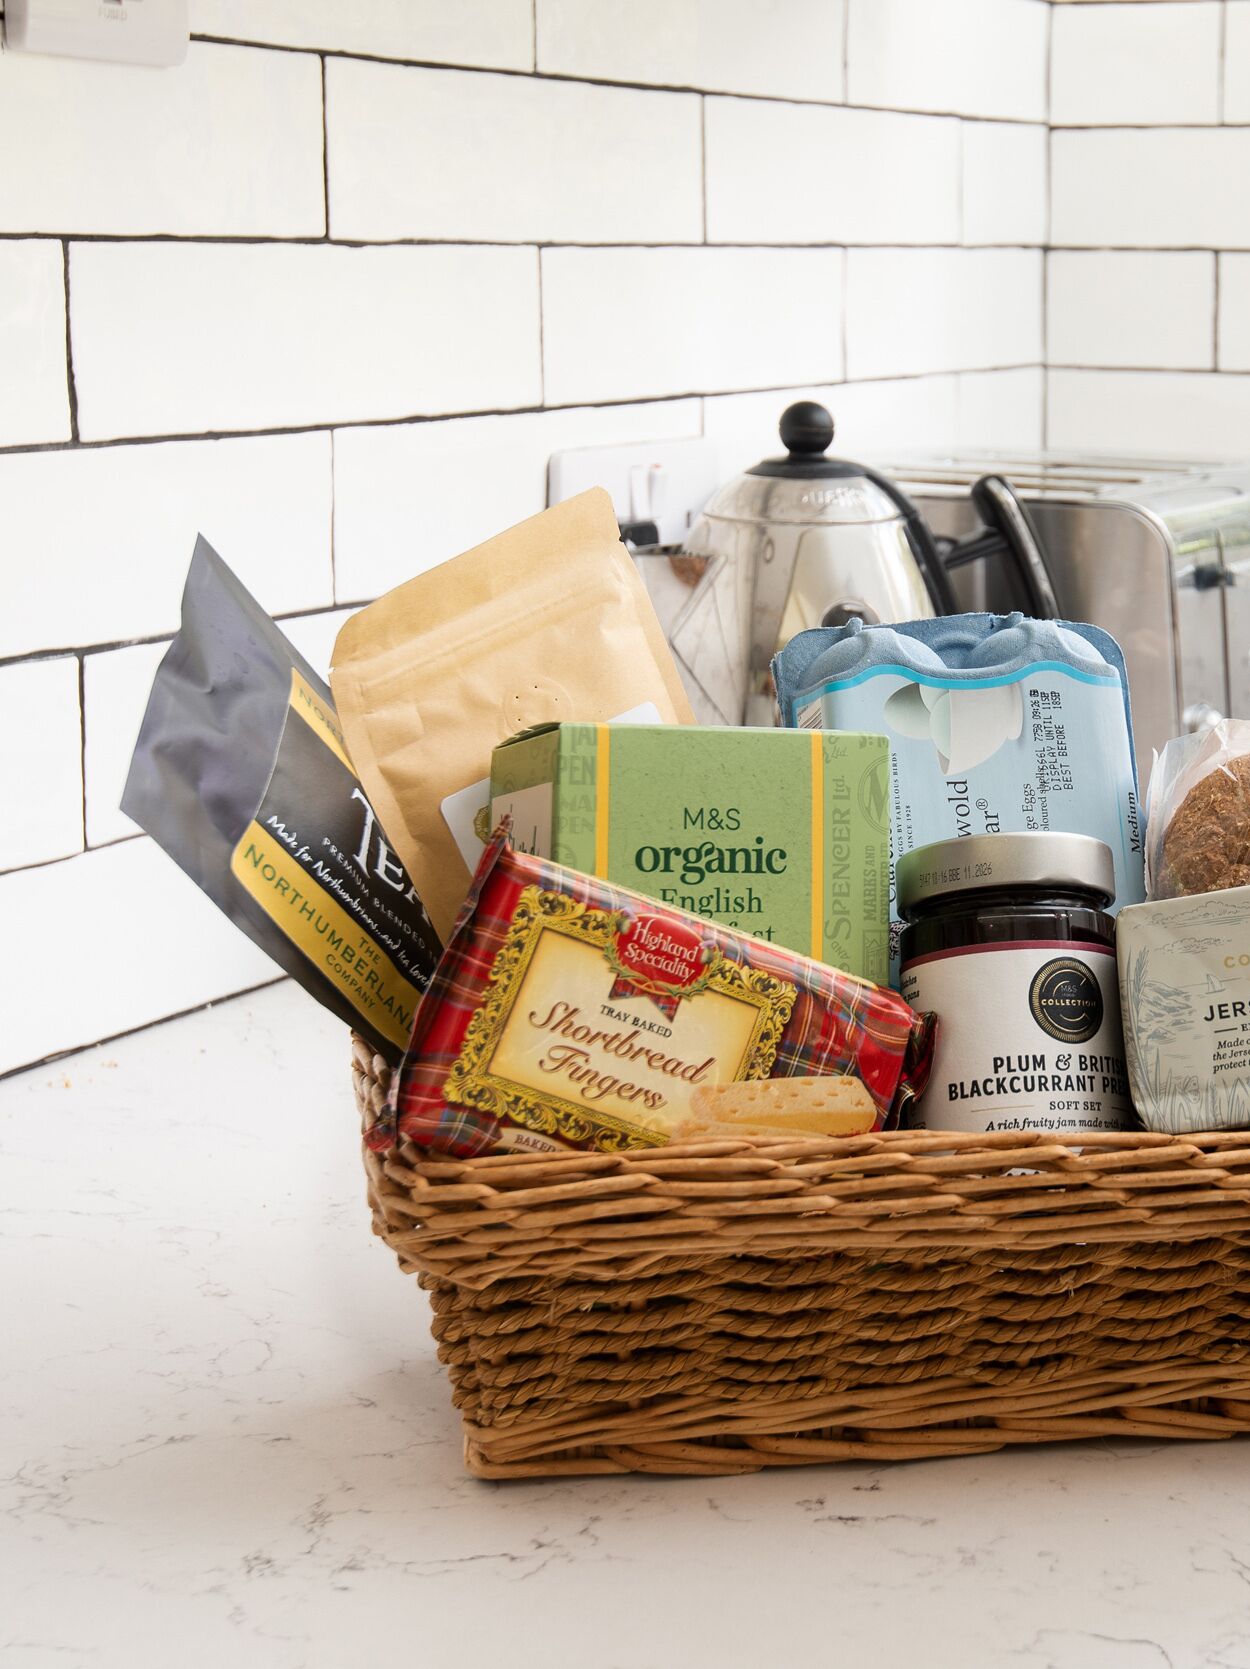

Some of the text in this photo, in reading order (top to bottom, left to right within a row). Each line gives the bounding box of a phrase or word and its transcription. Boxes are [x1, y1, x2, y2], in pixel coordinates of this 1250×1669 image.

[1043, 715, 1055, 741] UNTIL
[1055, 724, 1068, 757] BEFORE
[1047, 745, 1062, 791] DISPLAY
[1060, 763, 1074, 790] BEST
[893, 778, 902, 821] FABULOUS
[1022, 783, 1036, 812] Eggs
[683, 807, 741, 831] M&S
[1128, 791, 1141, 854] Medium
[266, 815, 304, 848] Made
[294, 846, 314, 865] for
[906, 822, 914, 849] SINCE
[635, 836, 787, 885] organic
[321, 836, 426, 950] PREMIUM BLENDED
[659, 887, 764, 919] English
[360, 936, 382, 965] THE
[632, 918, 699, 962] Highland
[624, 942, 696, 982] Speciality
[326, 953, 376, 1010] COMPANY
[1060, 984, 1078, 993] M&S
[600, 1004, 673, 1039] TRAY BAKED
[528, 1000, 717, 1084] Shortbread
[1213, 1051, 1227, 1061] the
[1216, 1037, 1245, 1050] Made
[538, 1044, 668, 1110] Fingers
[992, 1054, 1046, 1075] PLUM
[1055, 1053, 1072, 1071] &
[1212, 1059, 1247, 1075] protect
[948, 1074, 1096, 1101] BLACKCURRANT
[1050, 1101, 1102, 1112] SOFT SET
[985, 1120, 996, 1132] A
[997, 1117, 1020, 1131] rich
[1019, 1117, 1056, 1132] fruity
[1055, 1117, 1077, 1129] jam
[1078, 1116, 1103, 1129] made
